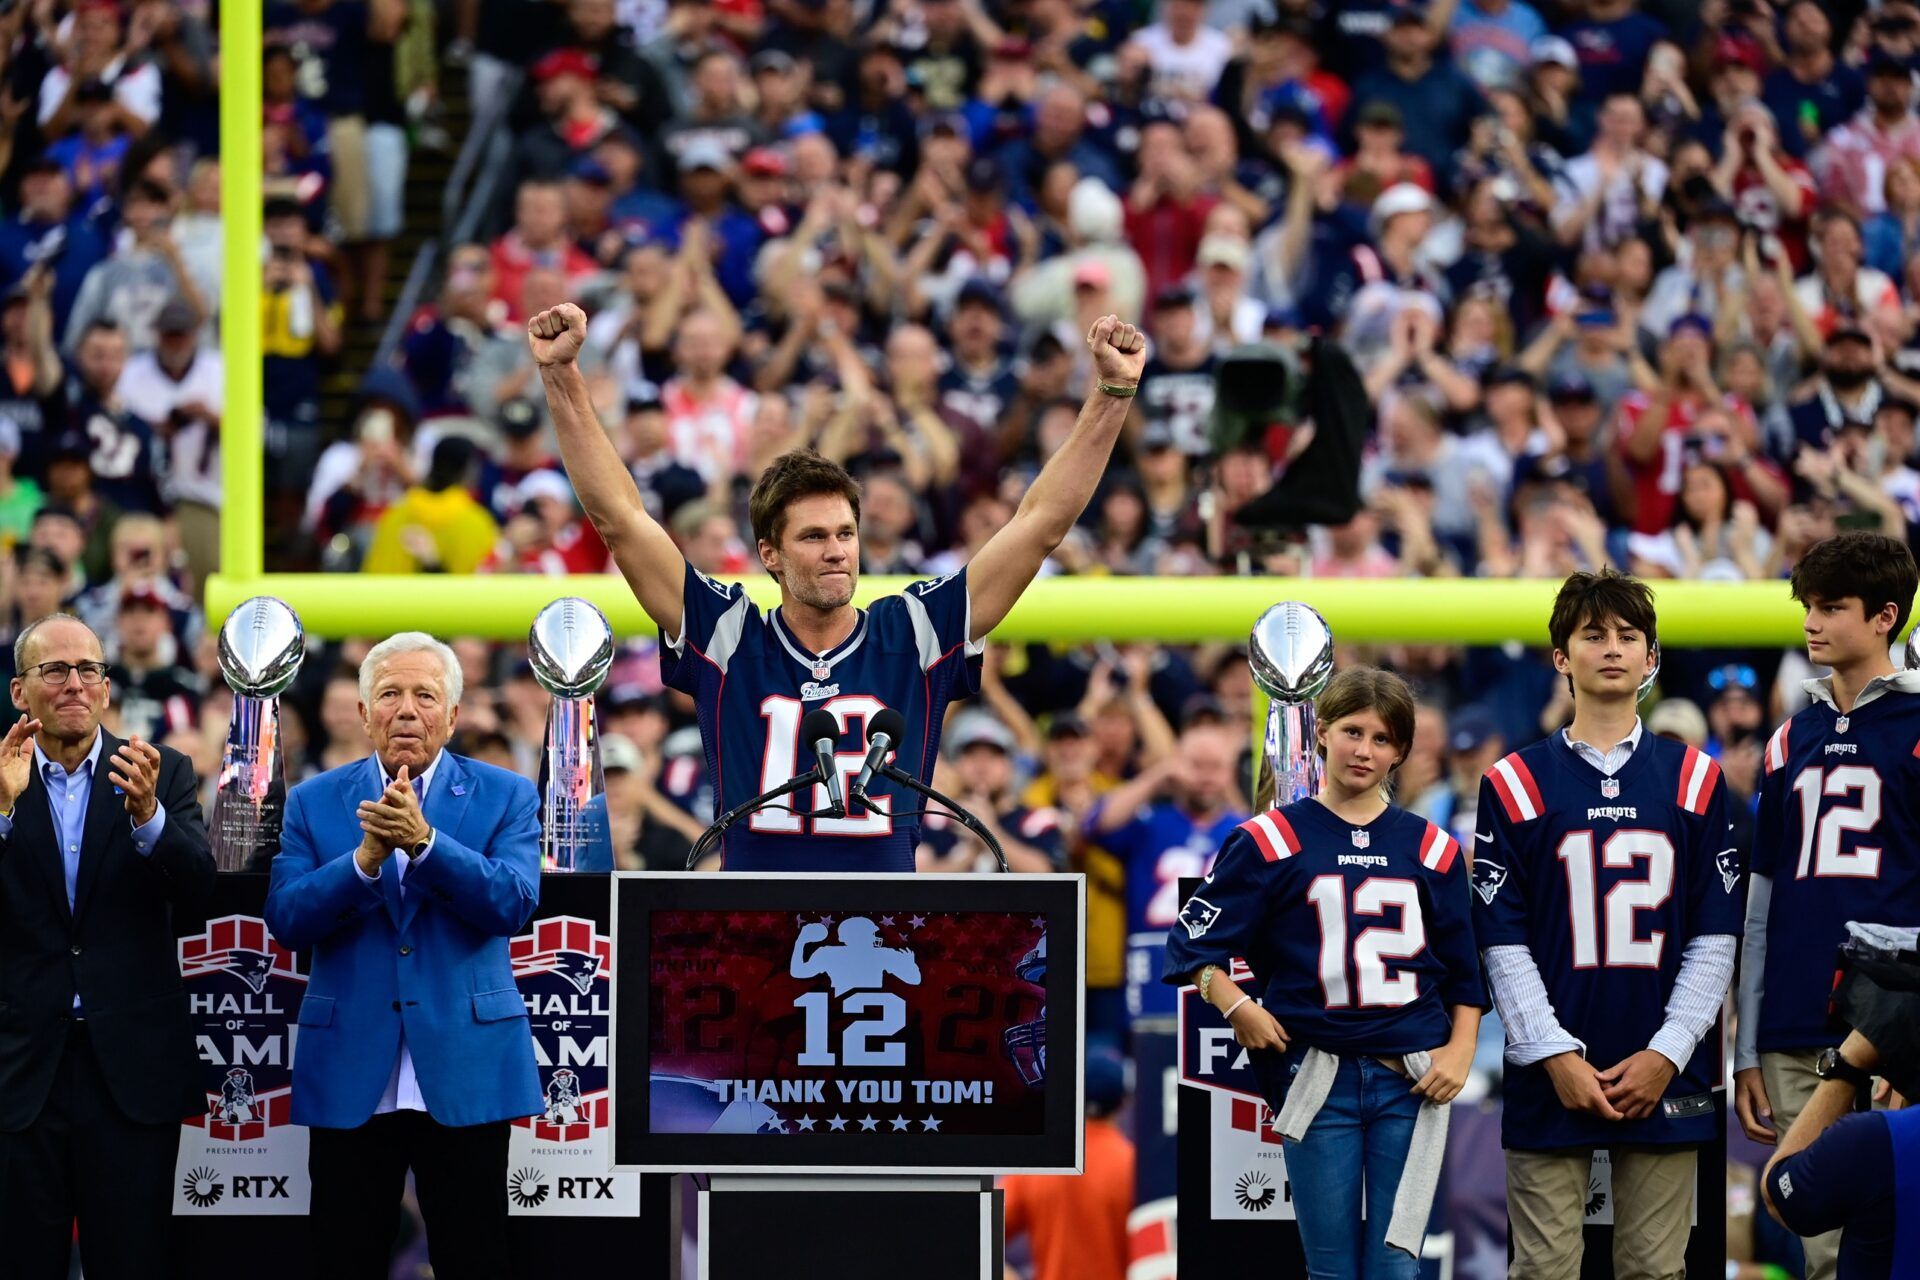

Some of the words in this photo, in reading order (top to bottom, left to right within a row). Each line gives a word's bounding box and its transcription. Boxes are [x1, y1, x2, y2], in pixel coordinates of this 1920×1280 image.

[1825, 743, 1857, 755] PATRIOTS
[750, 694, 896, 837] 12
[1603, 788, 1617, 796] NFL
[1587, 807, 1637, 821] PATRIOTS
[1793, 764, 1882, 881] 12
[1355, 837, 1369, 846] NFL
[1338, 854, 1388, 867] PATRIOTS
[1557, 829, 1676, 971] 12
[1306, 874, 1427, 1010] 12
[190, 993, 284, 1014] HALL
[521, 994, 610, 1016] HALL
[225, 1020, 245, 1030] OF
[551, 1021, 572, 1031] OF
[793, 992, 907, 1066] 12
[718, 1080, 826, 1103] THANK
[835, 1080, 902, 1104] YOU
[911, 1081, 994, 1104] TOM!
[206, 1147, 254, 1155] PRESENTED
[531, 1148, 579, 1156] PRESENTED
[232, 1176, 290, 1198] RTX
[558, 1177, 614, 1199] RTX
